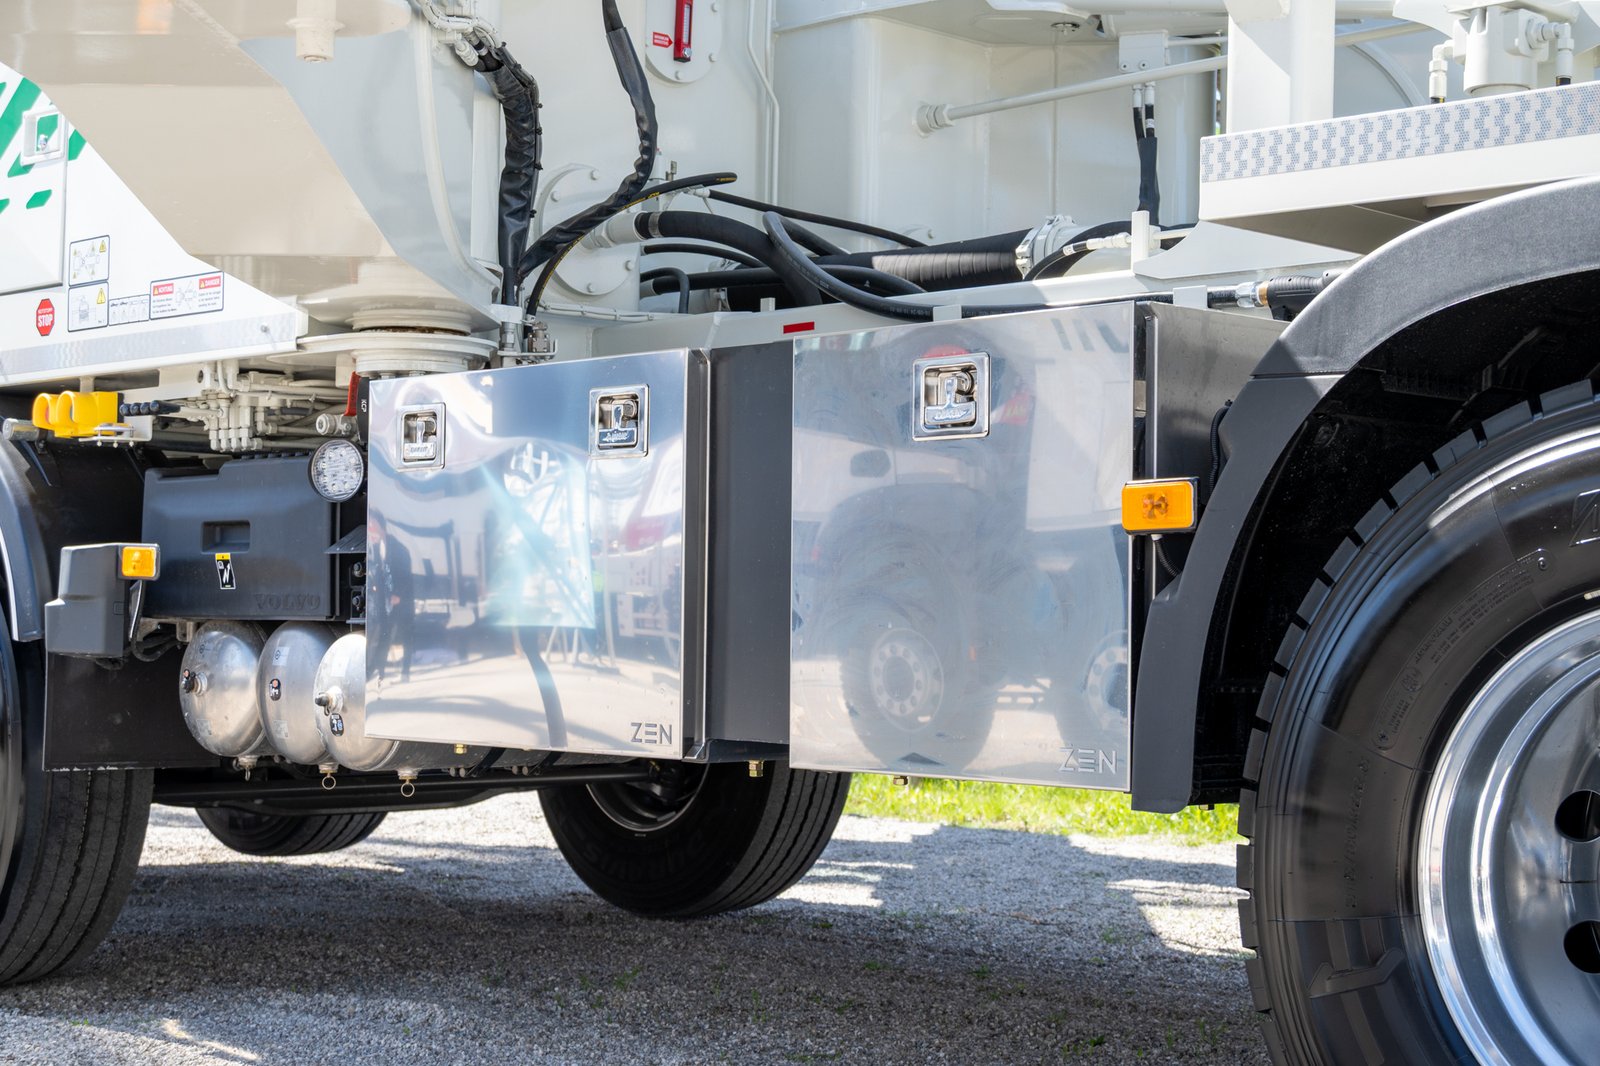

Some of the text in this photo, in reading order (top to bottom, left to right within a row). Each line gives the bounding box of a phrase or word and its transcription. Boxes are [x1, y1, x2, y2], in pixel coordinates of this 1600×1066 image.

[38, 313, 53, 328] STOP
[255, 593, 321, 610] VOLVO
[630, 722, 673, 745] ZEN
[1057, 747, 1118, 775] ZEN
